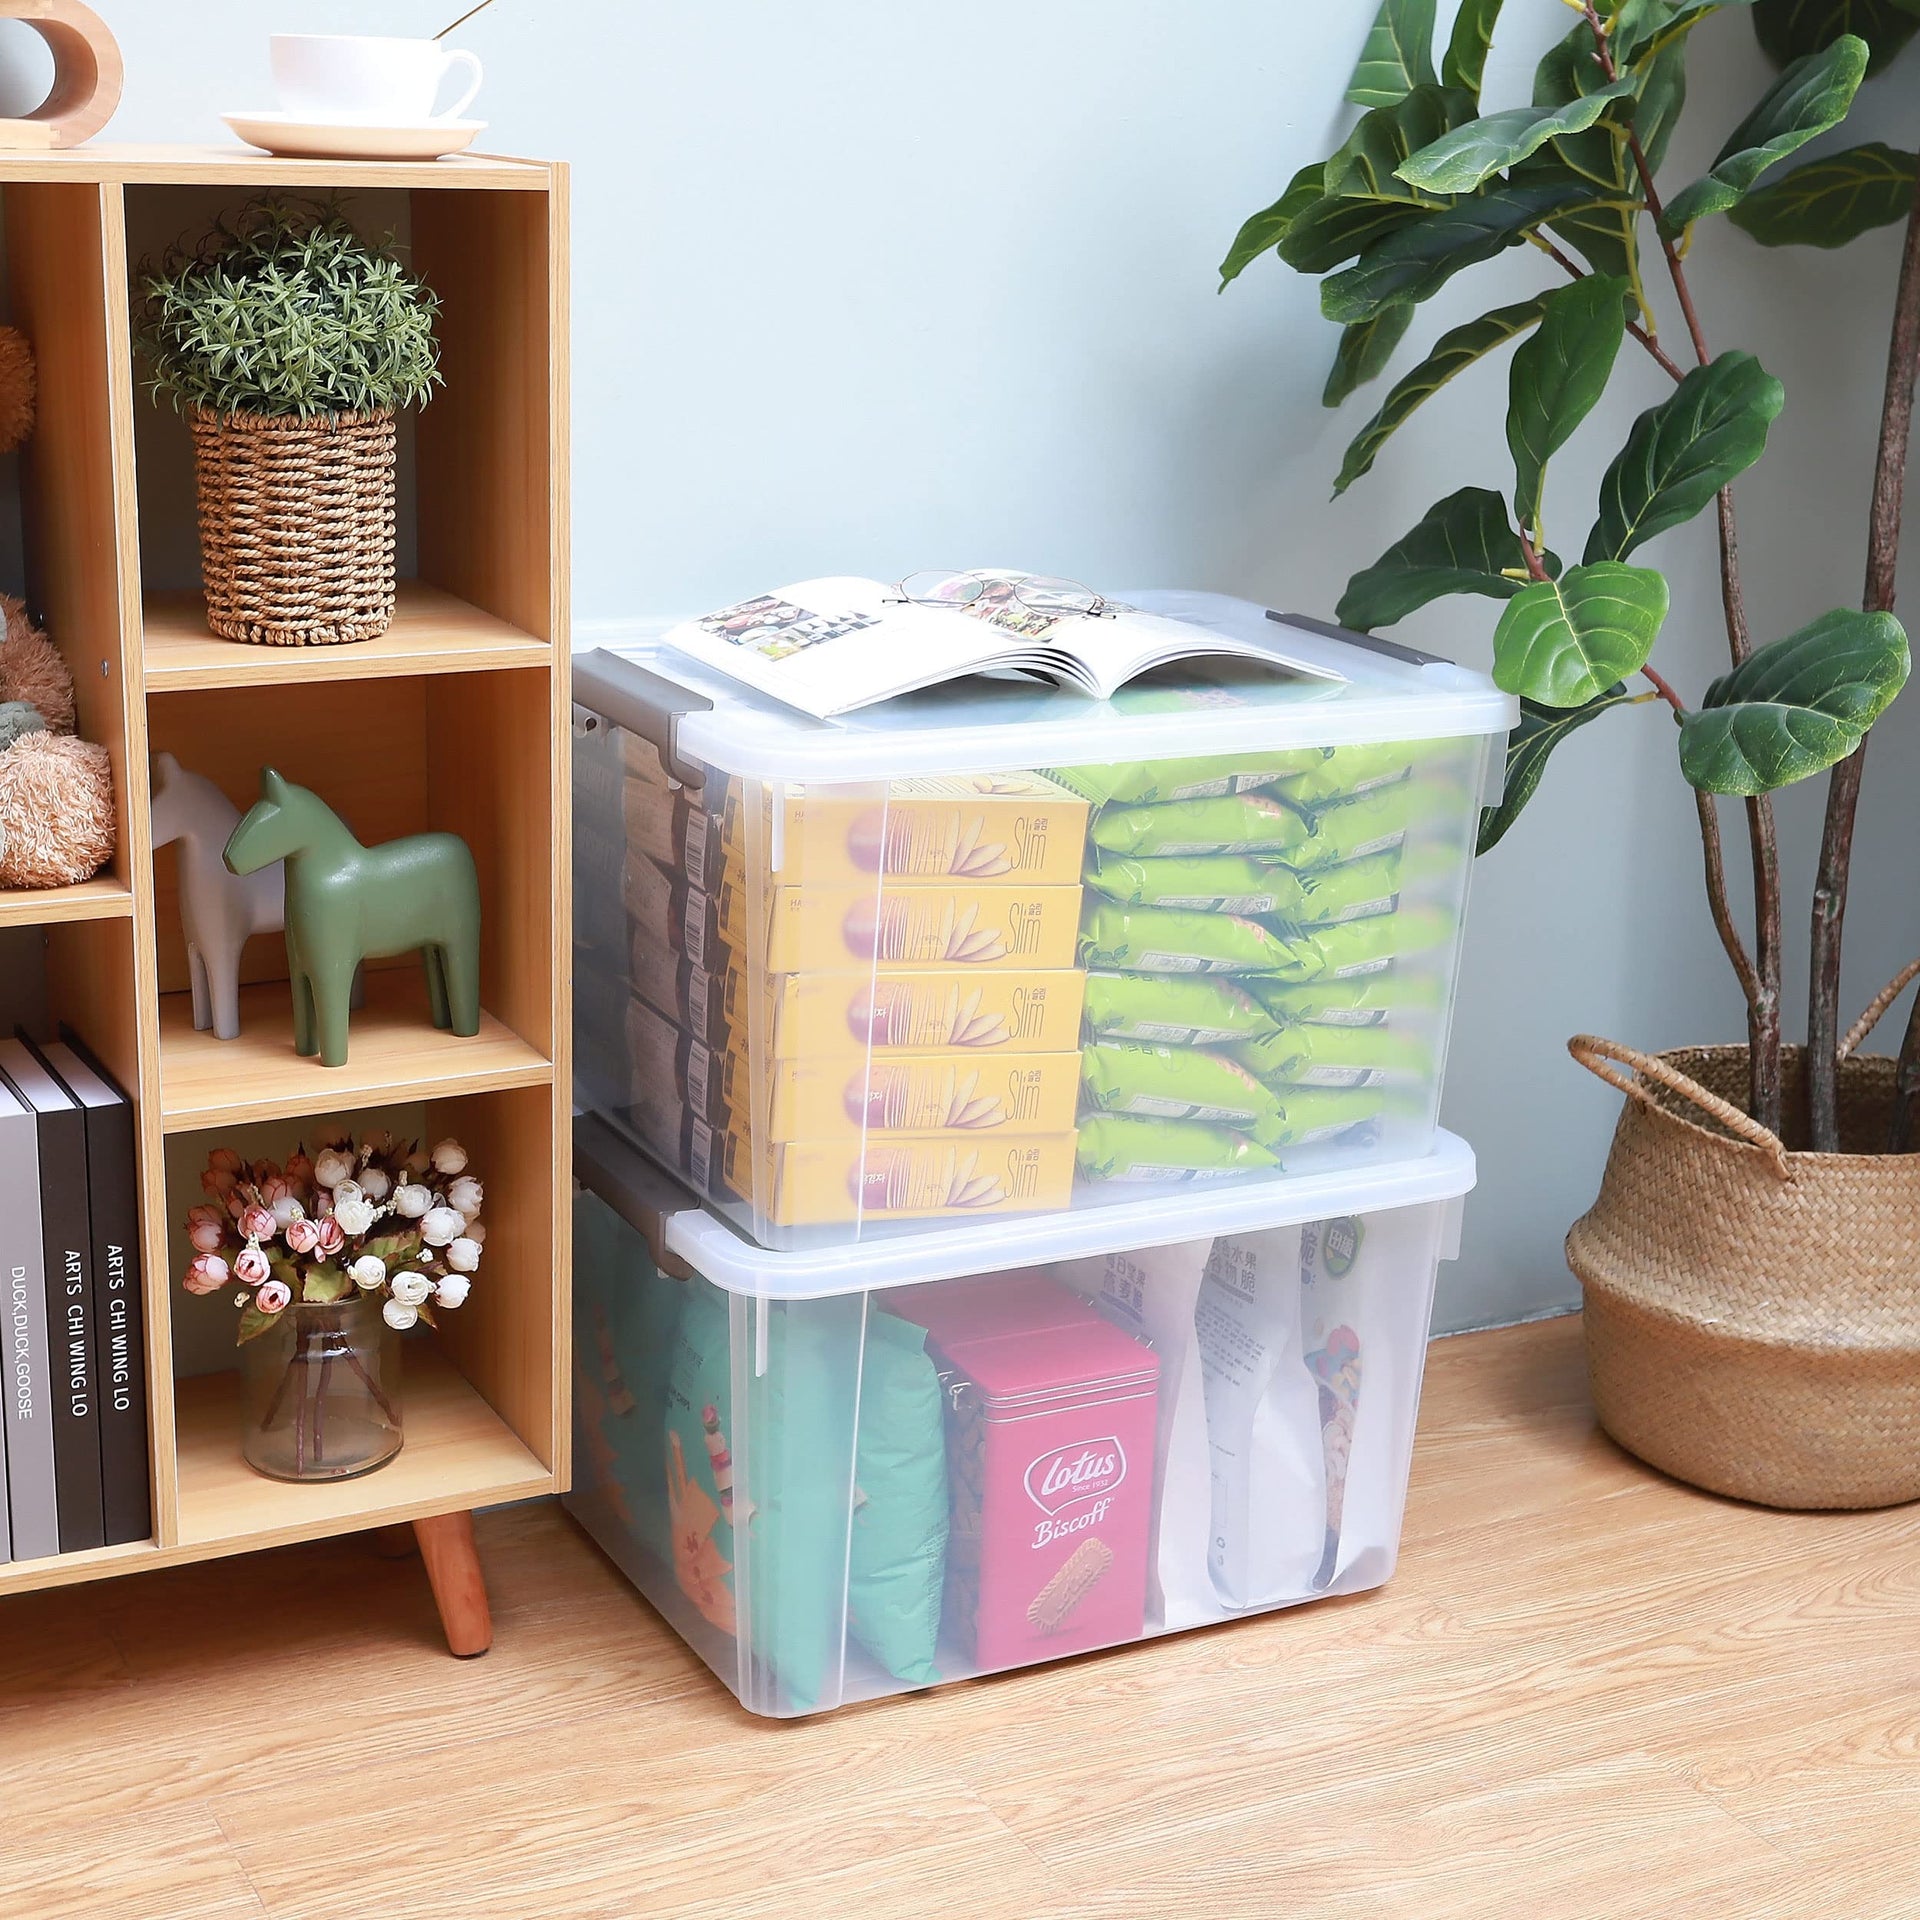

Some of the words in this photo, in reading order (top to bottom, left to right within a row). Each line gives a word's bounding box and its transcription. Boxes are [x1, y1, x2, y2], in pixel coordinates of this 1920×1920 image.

[1011, 817, 1046, 869] Slim
[1006, 902, 1041, 954] Slim
[1009, 987, 1045, 1038] Slim
[1005, 1070, 1040, 1120] Slim
[1004, 1149, 1039, 1198] Slim
[65, 1250, 83, 1296] ARTS
[107, 1245, 125, 1290] ARTS
[67, 1304, 84, 1336] CHI
[110, 1299, 126, 1330] CHI
[11, 1266, 32, 1420] DUCK,DUCK,GOOSE
[69, 1340, 87, 1389] WING
[111, 1334, 129, 1383] WING
[71, 1393, 88, 1417] LO
[113, 1387, 130, 1411] LO
[1041, 1451, 1115, 1495] Lotus
[1072, 1484, 1091, 1493] Since
[1093, 1479, 1109, 1488] 1932
[1031, 1497, 1111, 1549] Biscoff
